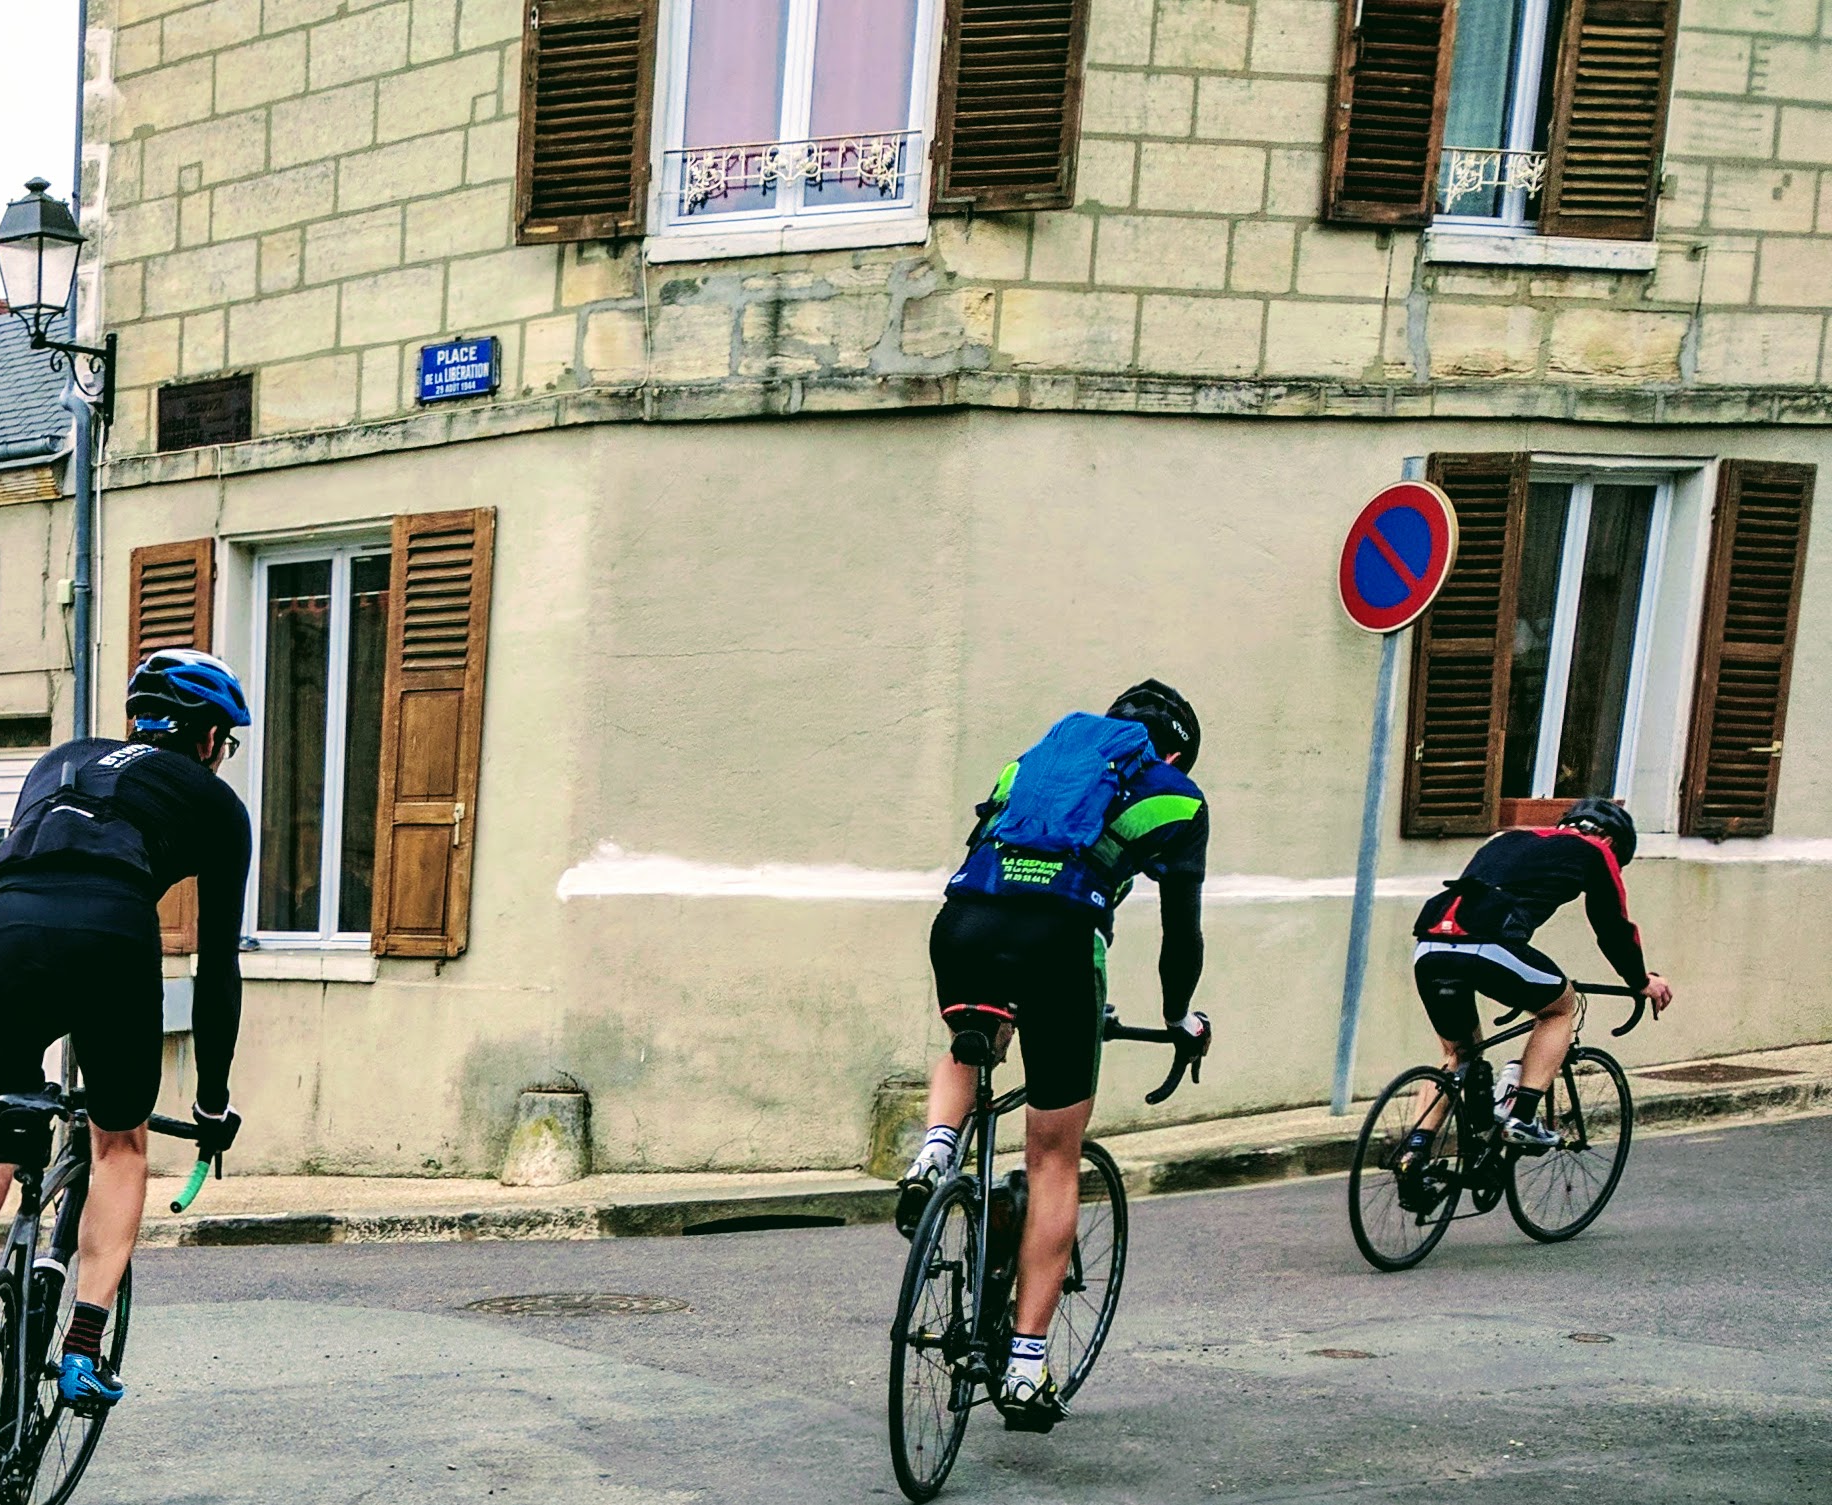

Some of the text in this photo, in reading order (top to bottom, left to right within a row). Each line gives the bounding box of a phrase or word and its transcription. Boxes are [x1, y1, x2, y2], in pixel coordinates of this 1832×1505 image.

[437, 346, 477, 366] PLACE
[424, 362, 490, 386] DE LA LIBÉRATION
[460, 381, 476, 391] 1944
[1001, 857, 1015, 866] LA
